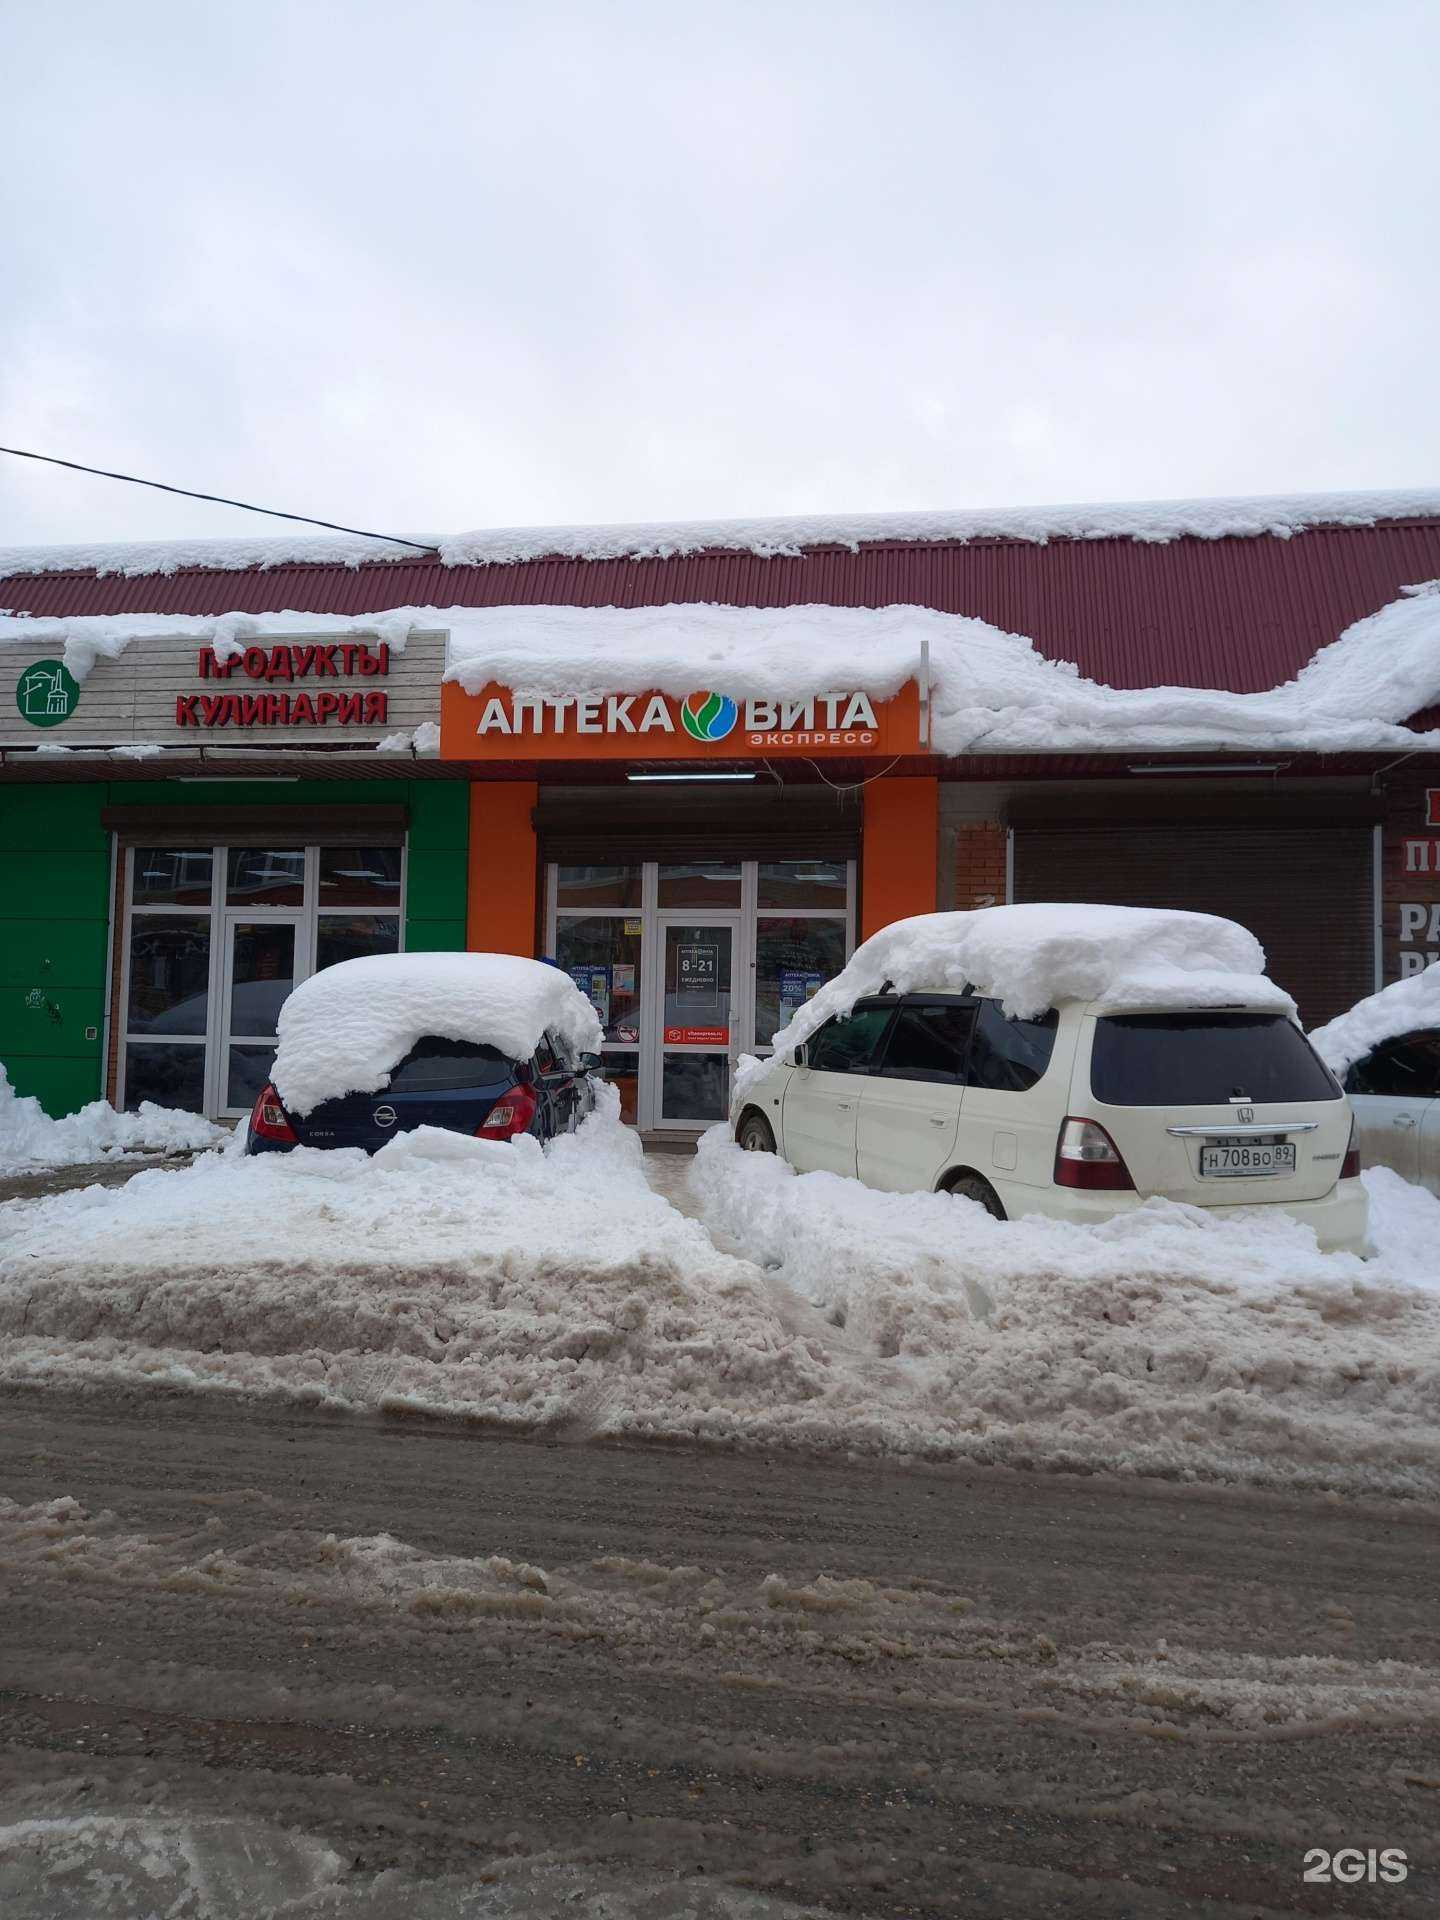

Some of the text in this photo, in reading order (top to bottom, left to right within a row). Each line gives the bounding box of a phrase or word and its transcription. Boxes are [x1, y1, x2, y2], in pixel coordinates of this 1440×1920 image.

[175, 690, 389, 727] КУЛИНАРИЯ
[476, 691, 879, 734] АПТЕКА ВИТА
[750, 732, 873, 745] ЭКСПРЕСС
[1404, 840, 1440, 872] П
[682, 959, 713, 972] 8-21
